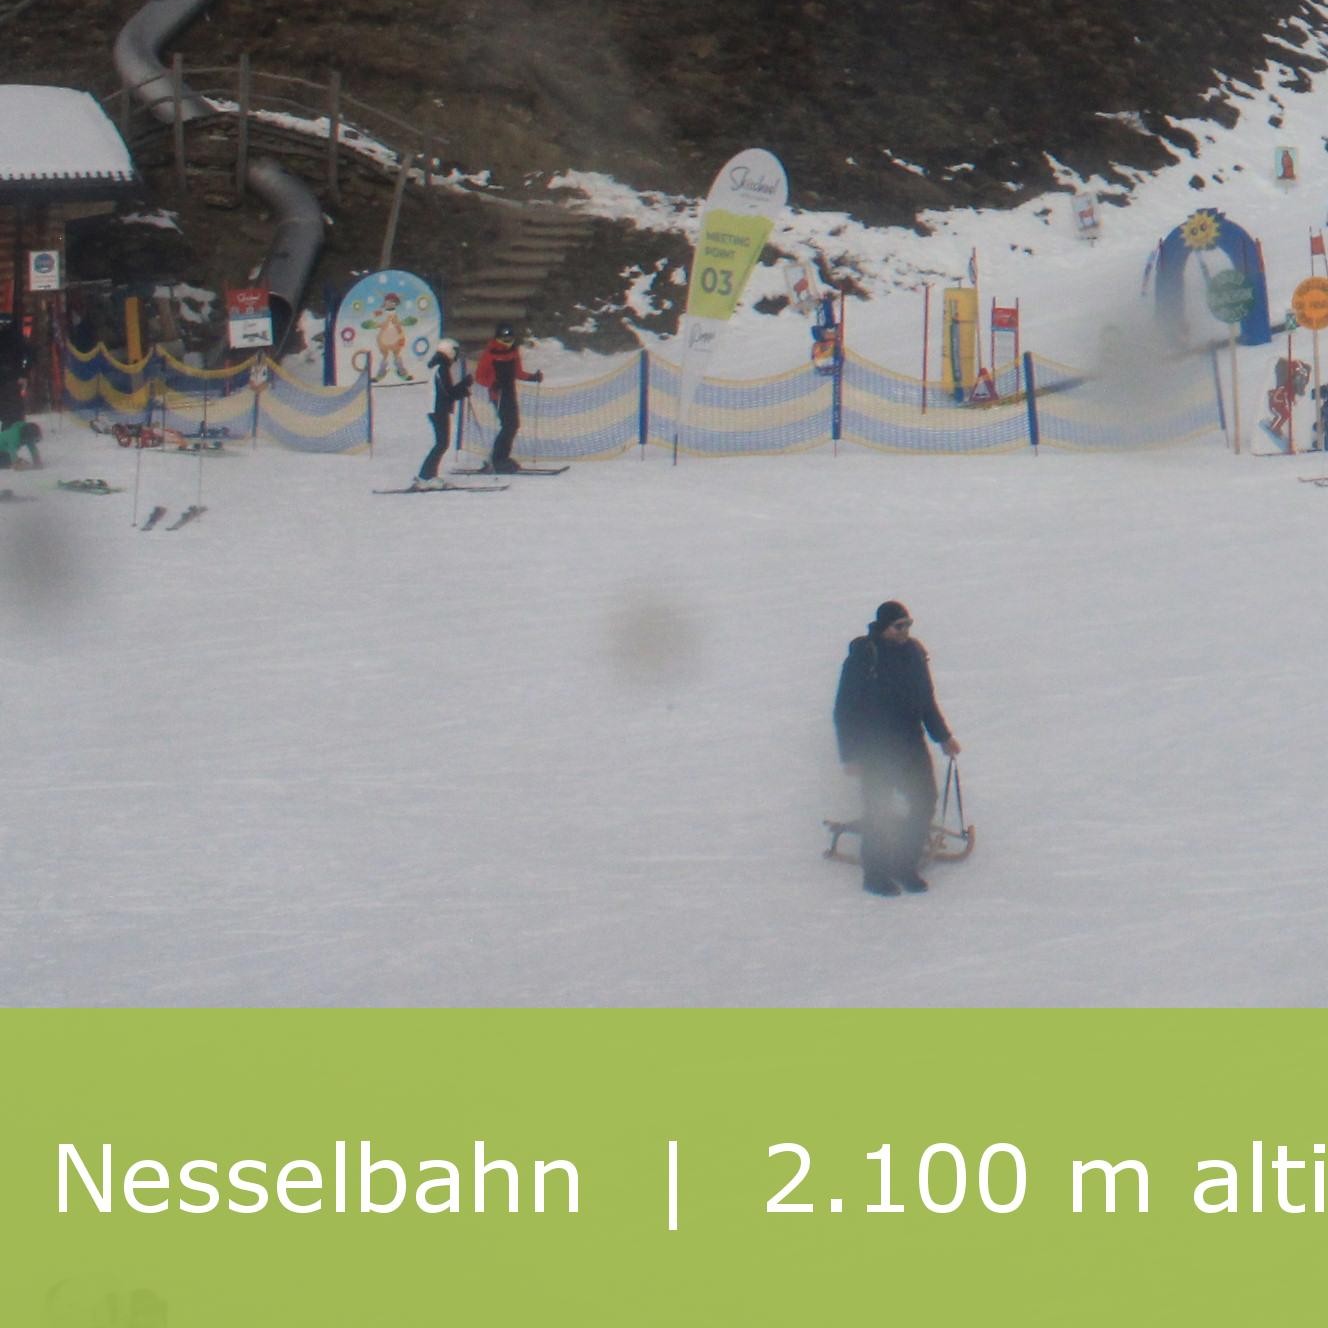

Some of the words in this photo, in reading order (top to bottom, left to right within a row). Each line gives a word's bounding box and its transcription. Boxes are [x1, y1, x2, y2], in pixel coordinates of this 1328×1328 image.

[705, 230, 750, 248] MEETING
[705, 246, 736, 259] POINT
[701, 267, 733, 296] 03
